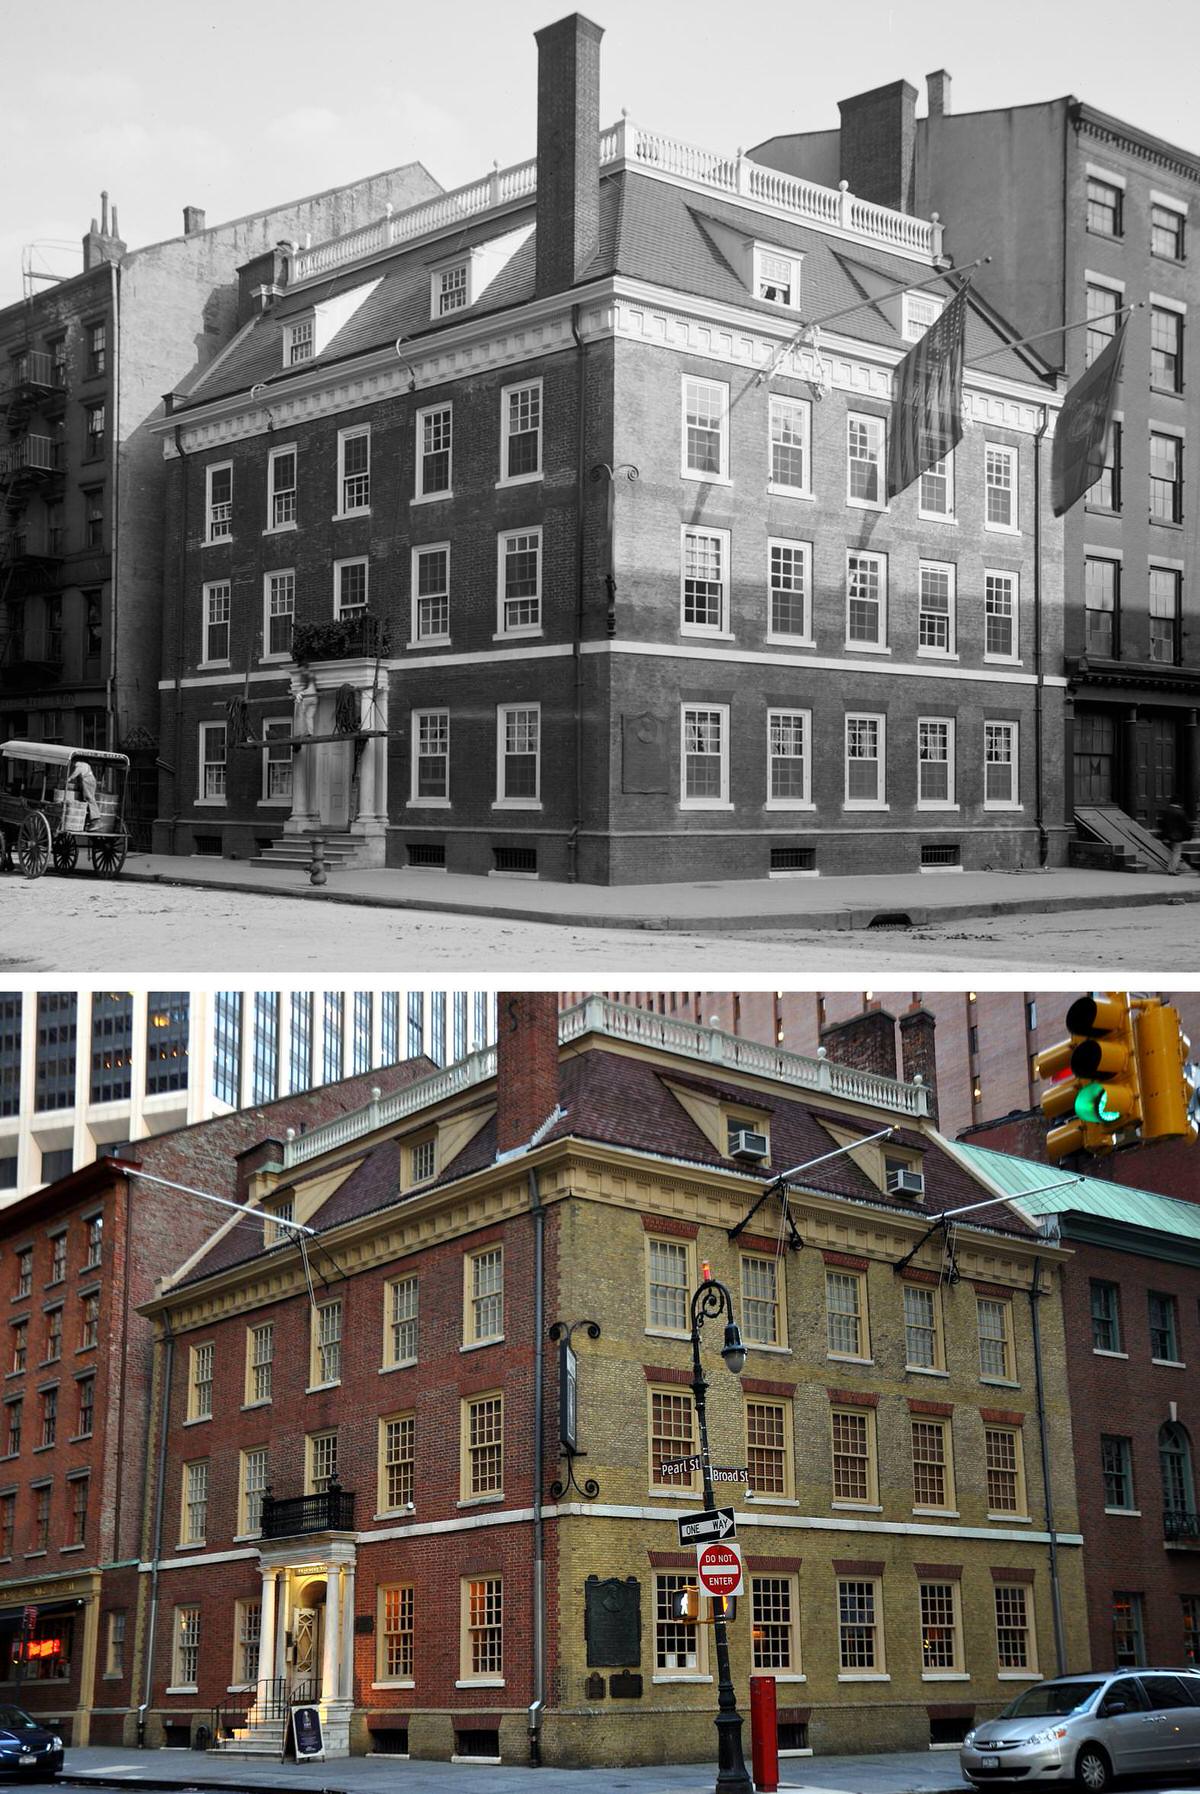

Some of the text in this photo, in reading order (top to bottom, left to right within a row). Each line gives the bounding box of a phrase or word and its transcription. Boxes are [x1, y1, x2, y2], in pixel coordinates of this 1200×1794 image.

[662, 1458, 700, 1476] Pearl St
[713, 1469, 750, 1482] Broad St
[685, 1519, 728, 1535] ONE WAY
[705, 1555, 733, 1563] DO NOT
[709, 1577, 733, 1586] ENTER
